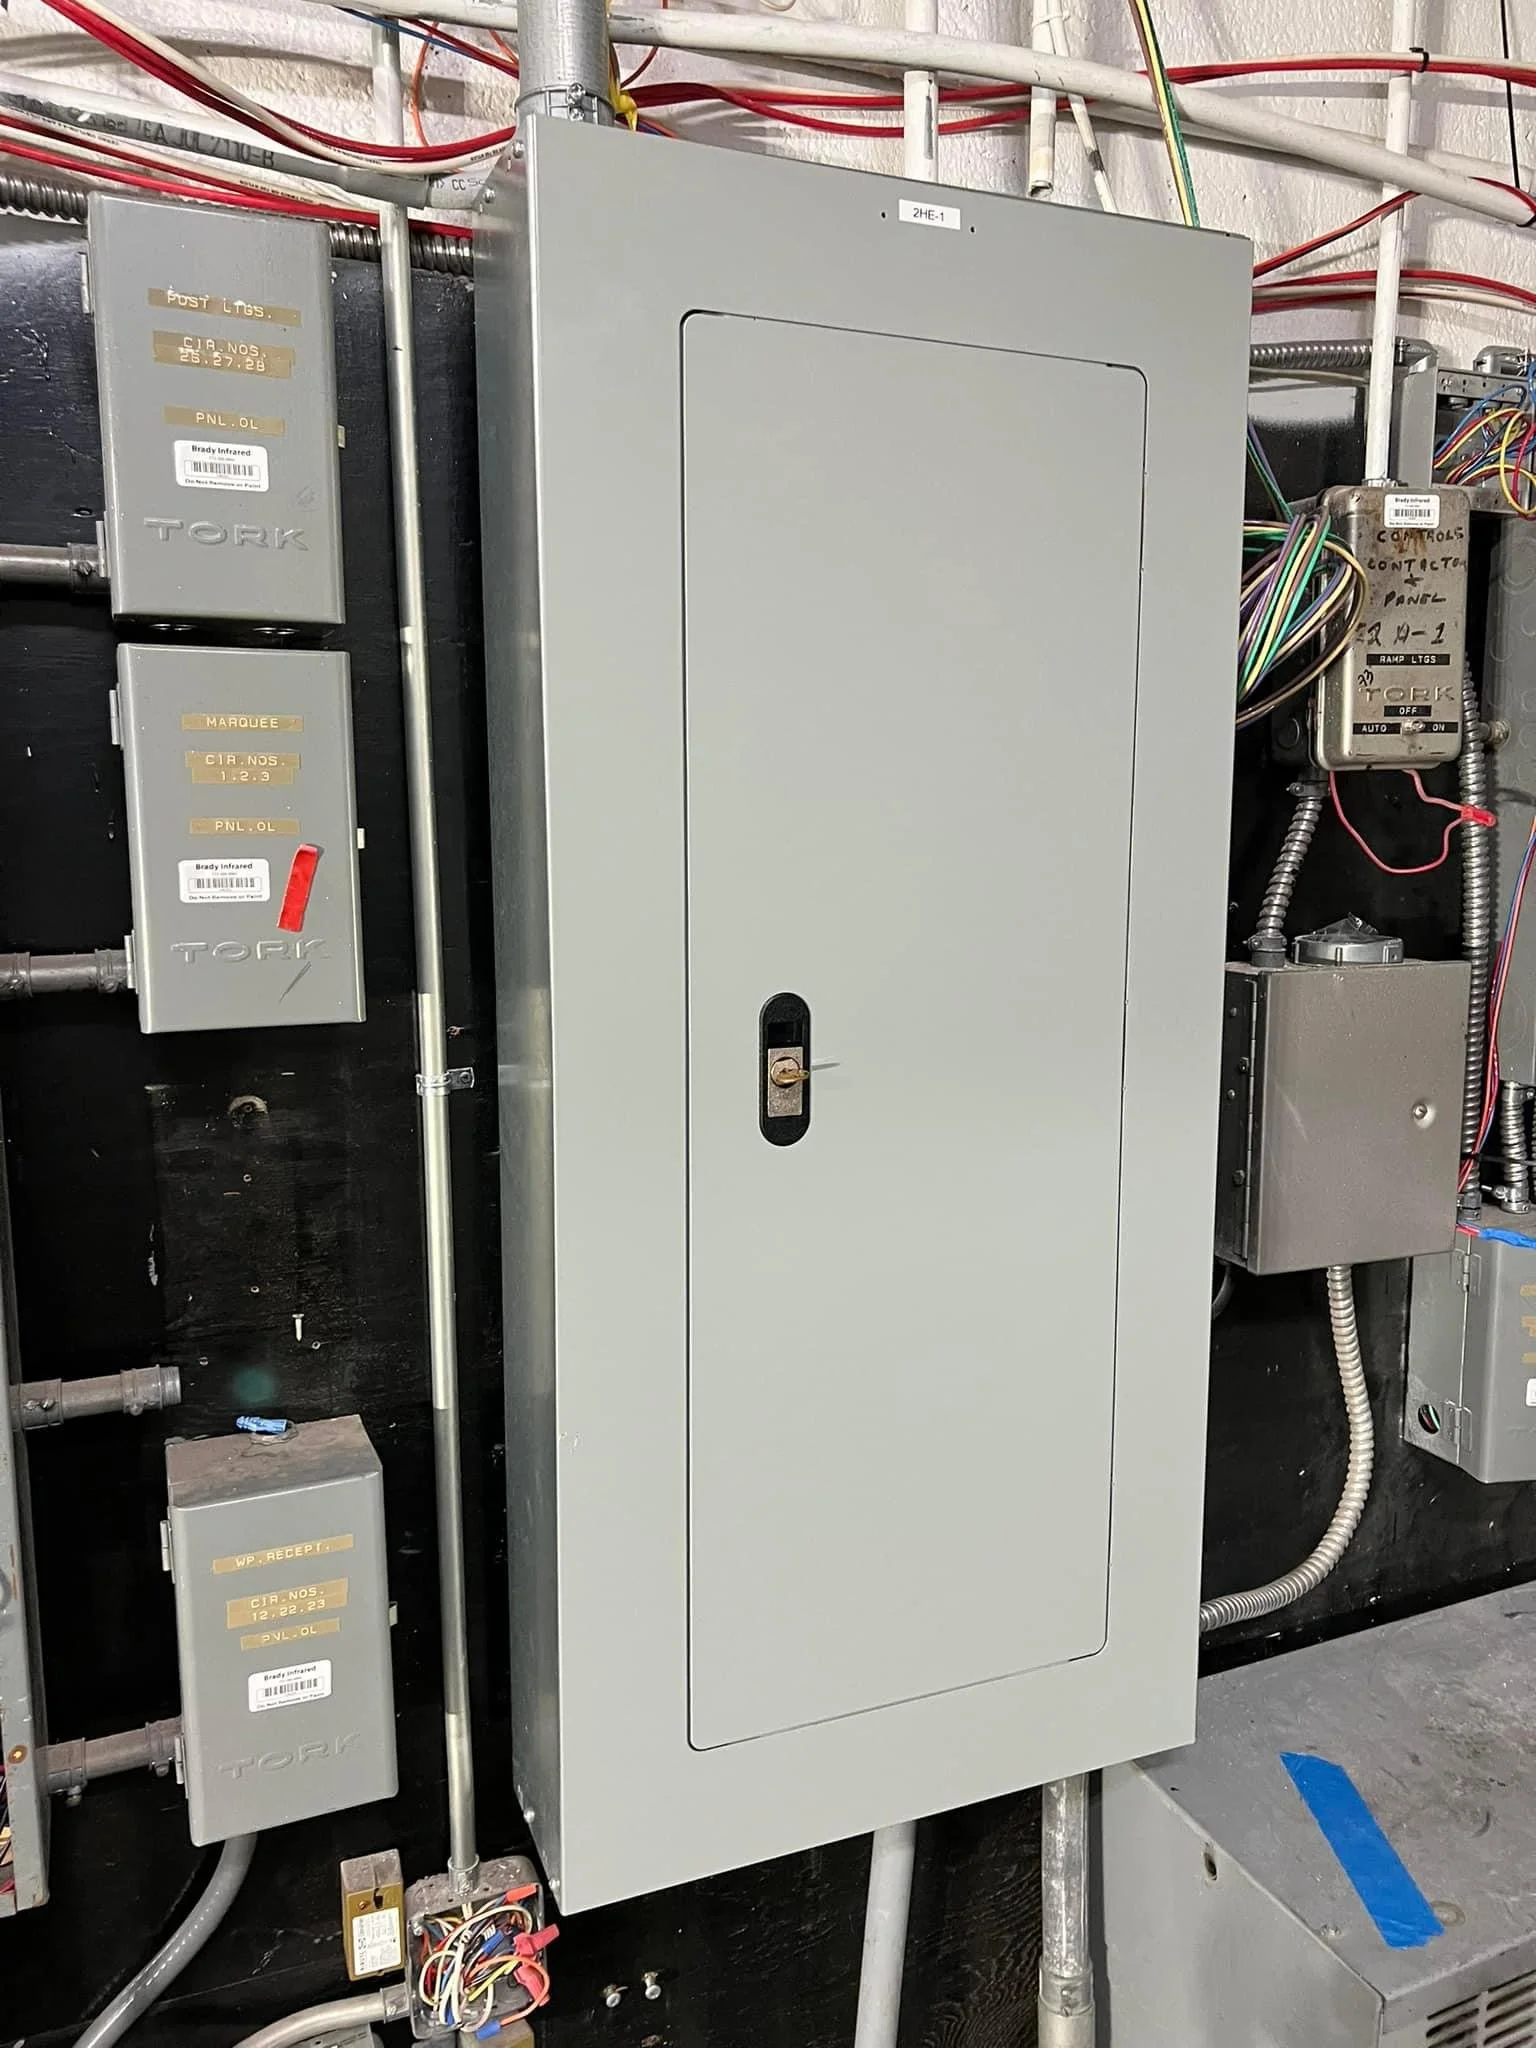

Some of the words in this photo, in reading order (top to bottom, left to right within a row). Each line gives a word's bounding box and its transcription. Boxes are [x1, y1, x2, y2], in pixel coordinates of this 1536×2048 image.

[912, 207, 945, 222] 2HE-1
[166, 288, 210, 309] POST
[222, 297, 273, 319] LTGS.
[191, 444, 216, 455] Brady
[217, 447, 252, 457] Infrared
[142, 516, 310, 552] TORK
[1383, 589, 1447, 608] PANEL
[1379, 655, 1405, 665] RAMP
[1411, 655, 1437, 665] LTGS
[1357, 685, 1455, 702] TORK
[1399, 706, 1417, 715] OFF
[205, 716, 280, 729] MARQUEE
[1361, 724, 1387, 733] AUTO
[1432, 723, 1445, 732] ON
[204, 753, 286, 767] CIR.NOS.
[220, 770, 271, 782] 1.2.3
[214, 820, 277, 832] PNL.OL
[195, 862, 219, 871] Brady
[220, 862, 253, 870] Infrared
[170, 938, 333, 963] TORK
[250, 1586, 325, 1609] CIR.NOS.
[251, 1599, 326, 1621] 12.22.23
[263, 1672, 286, 1681] Brady
[286, 1665, 317, 1677] Infrared
[215, 1730, 361, 1780] TORK
